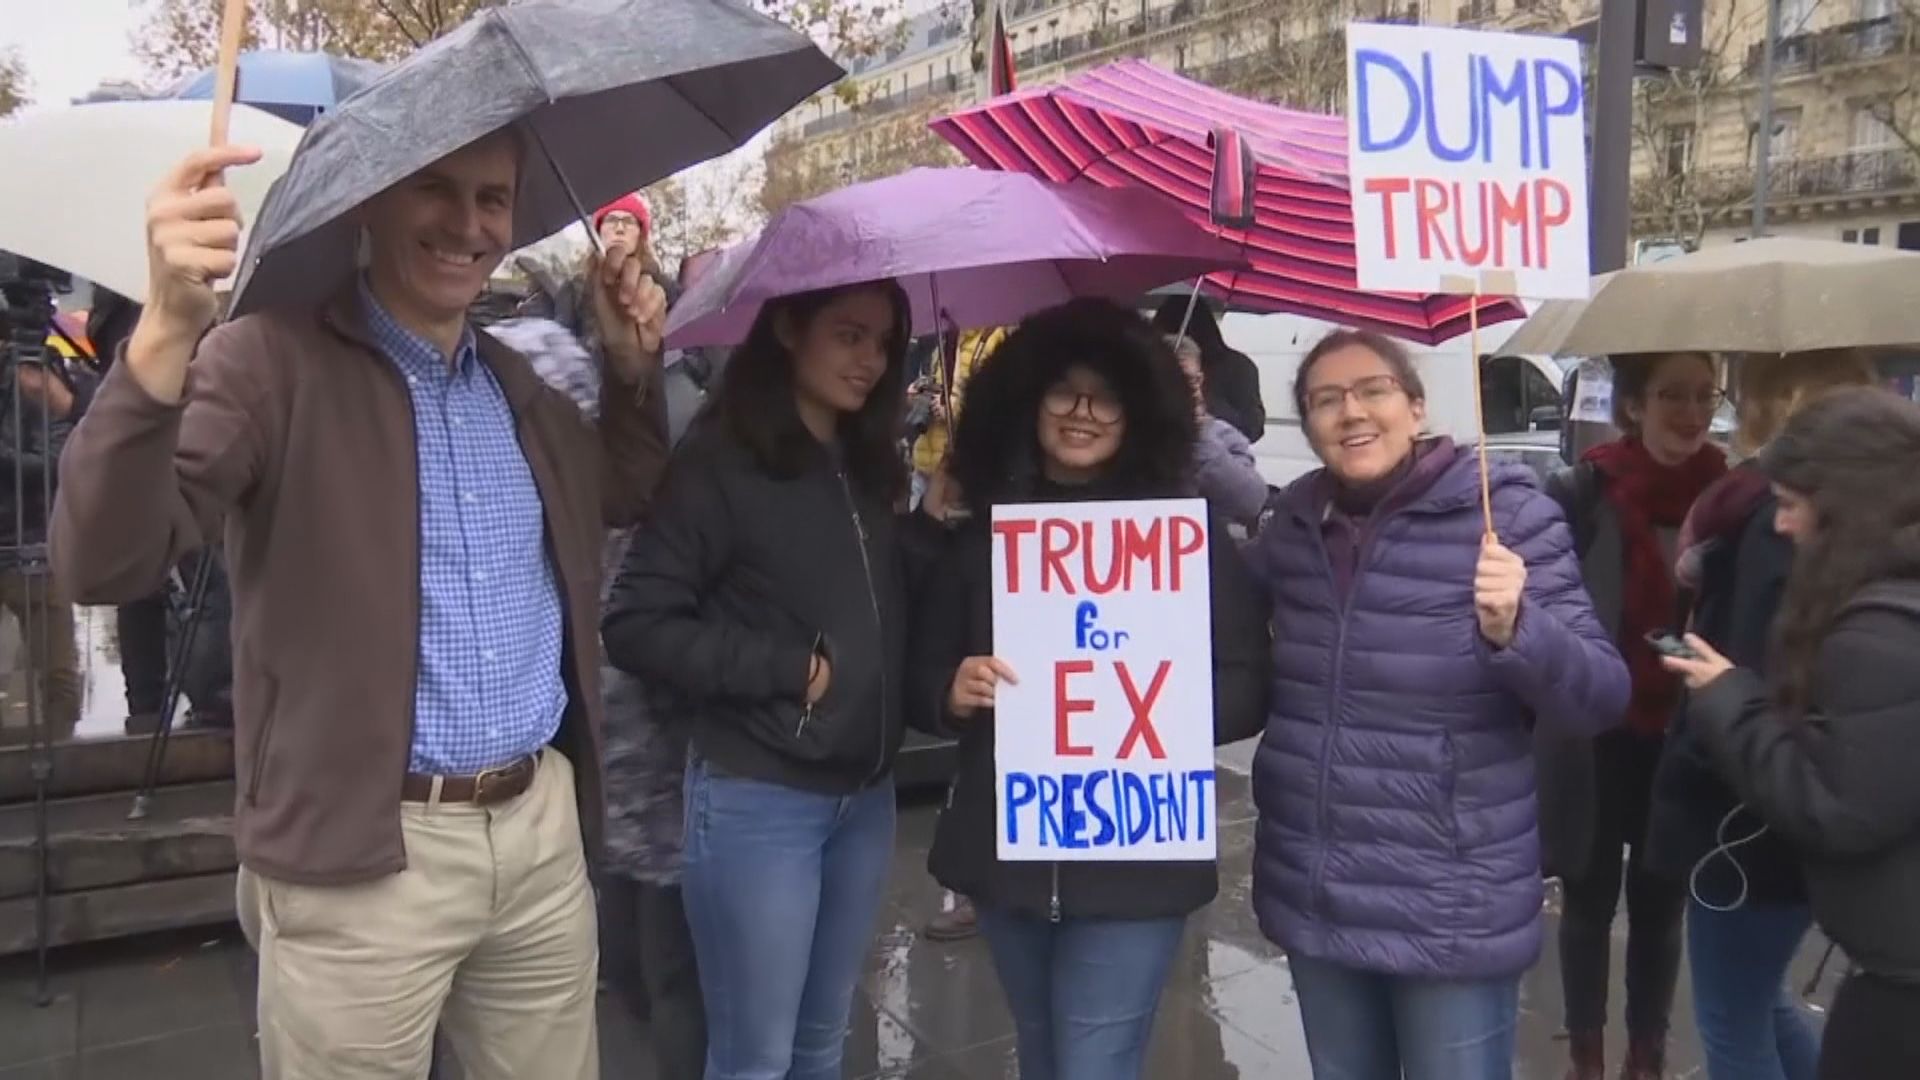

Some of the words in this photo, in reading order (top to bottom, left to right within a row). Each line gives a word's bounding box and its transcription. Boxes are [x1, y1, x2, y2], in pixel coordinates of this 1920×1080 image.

[1355, 49, 1582, 168] DUMP
[1365, 178, 1571, 269] TRUMP
[993, 516, 1204, 594] TRUMP
[1075, 599, 1129, 651] for
[1055, 660, 1172, 760] EX
[1005, 768, 1214, 849] PRESIDENT
